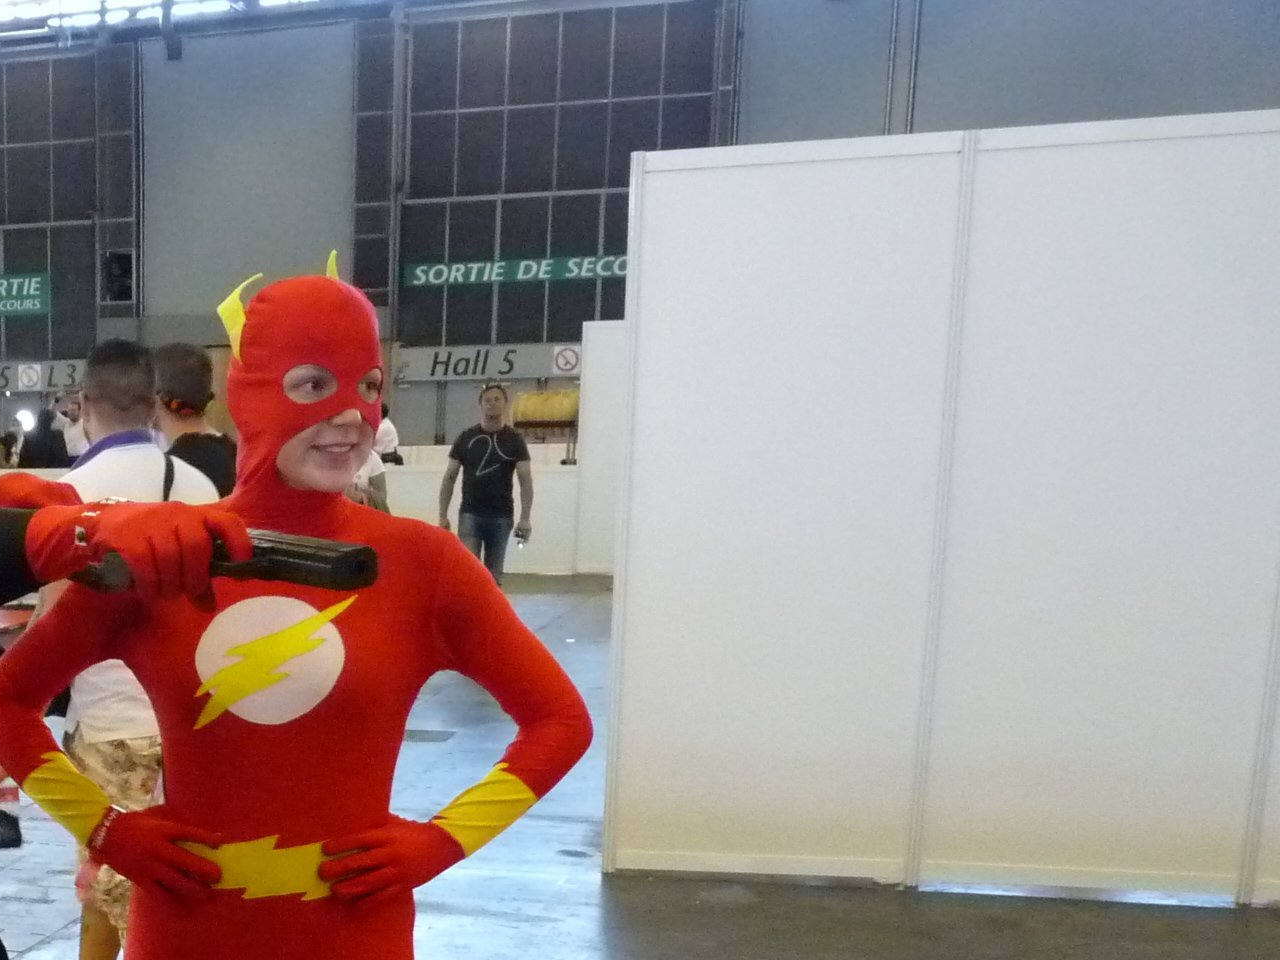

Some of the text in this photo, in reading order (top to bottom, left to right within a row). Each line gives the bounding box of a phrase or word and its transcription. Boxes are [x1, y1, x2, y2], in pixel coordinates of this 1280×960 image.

[413, 262, 506, 285] SORTIE
[517, 259, 554, 279] DE
[47, 363, 77, 387] L3
[430, 350, 518, 376] Hall 5
